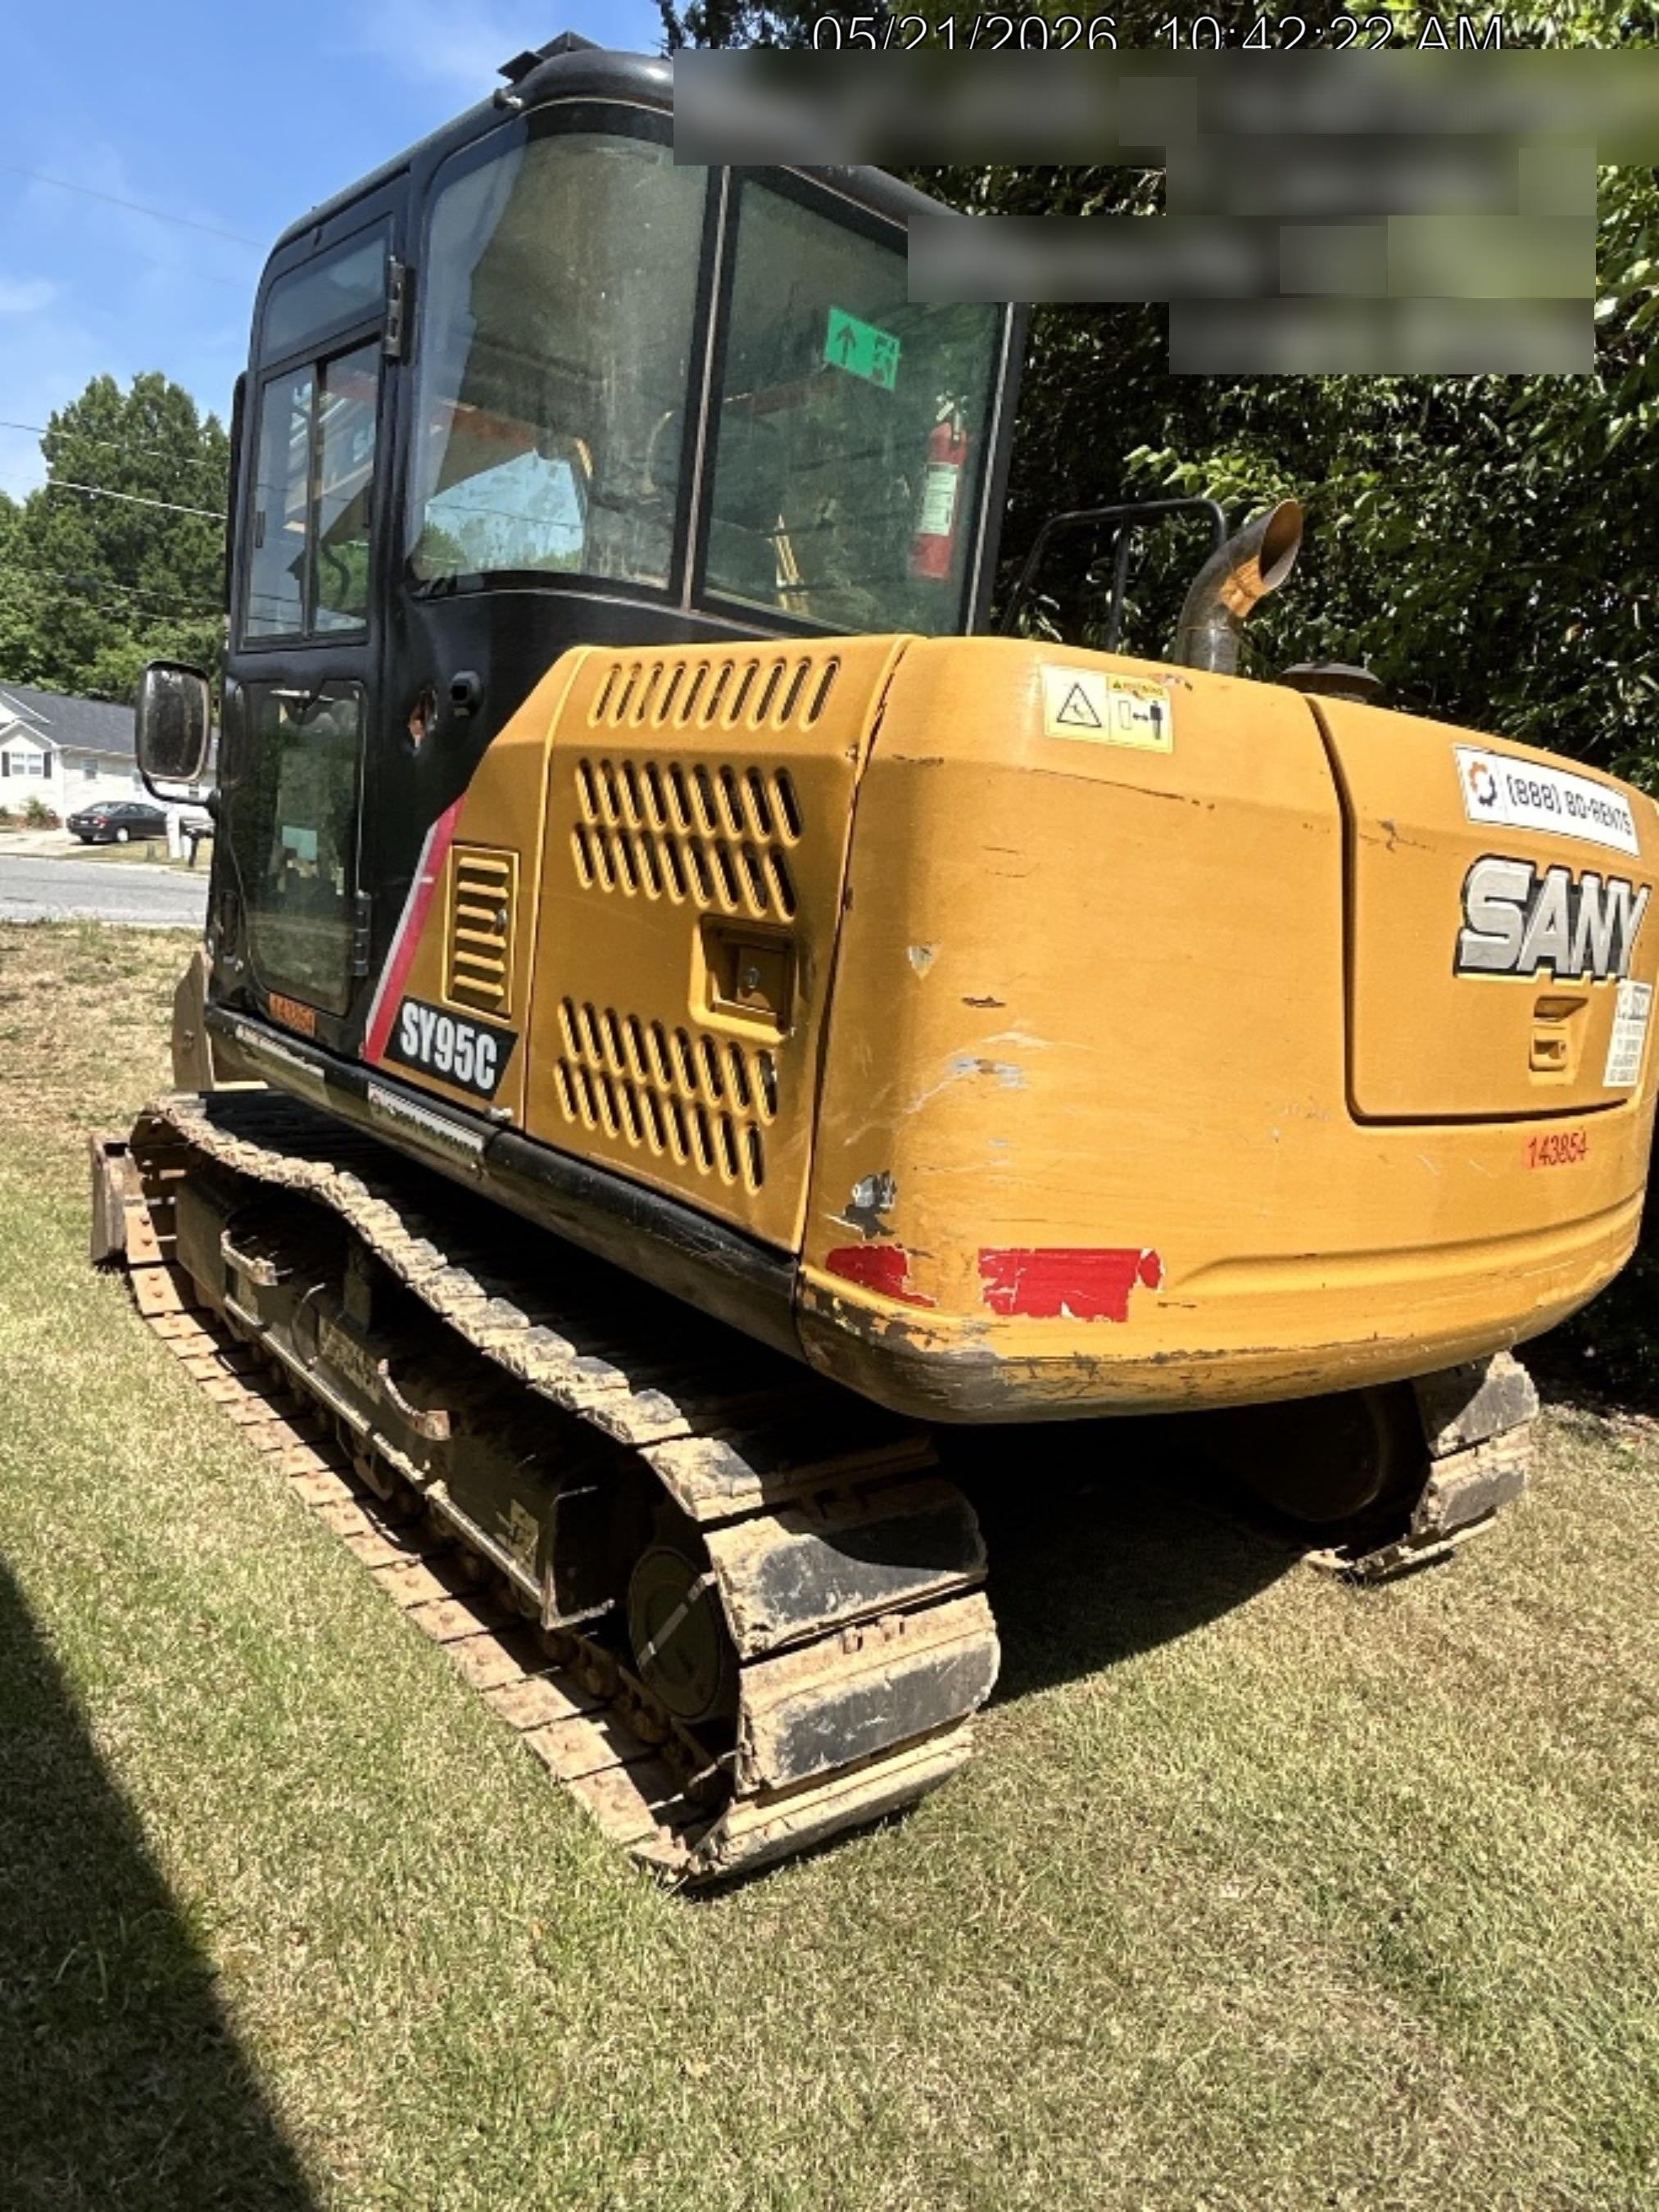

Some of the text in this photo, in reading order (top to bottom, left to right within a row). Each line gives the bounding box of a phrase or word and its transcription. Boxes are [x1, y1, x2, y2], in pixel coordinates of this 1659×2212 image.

[1506, 774, 1633, 836] (888) 80-RENTS
[1454, 854, 1652, 981] SANY
[400, 1001, 497, 1090] SY95C
[1528, 1130, 1590, 1168] 143854
